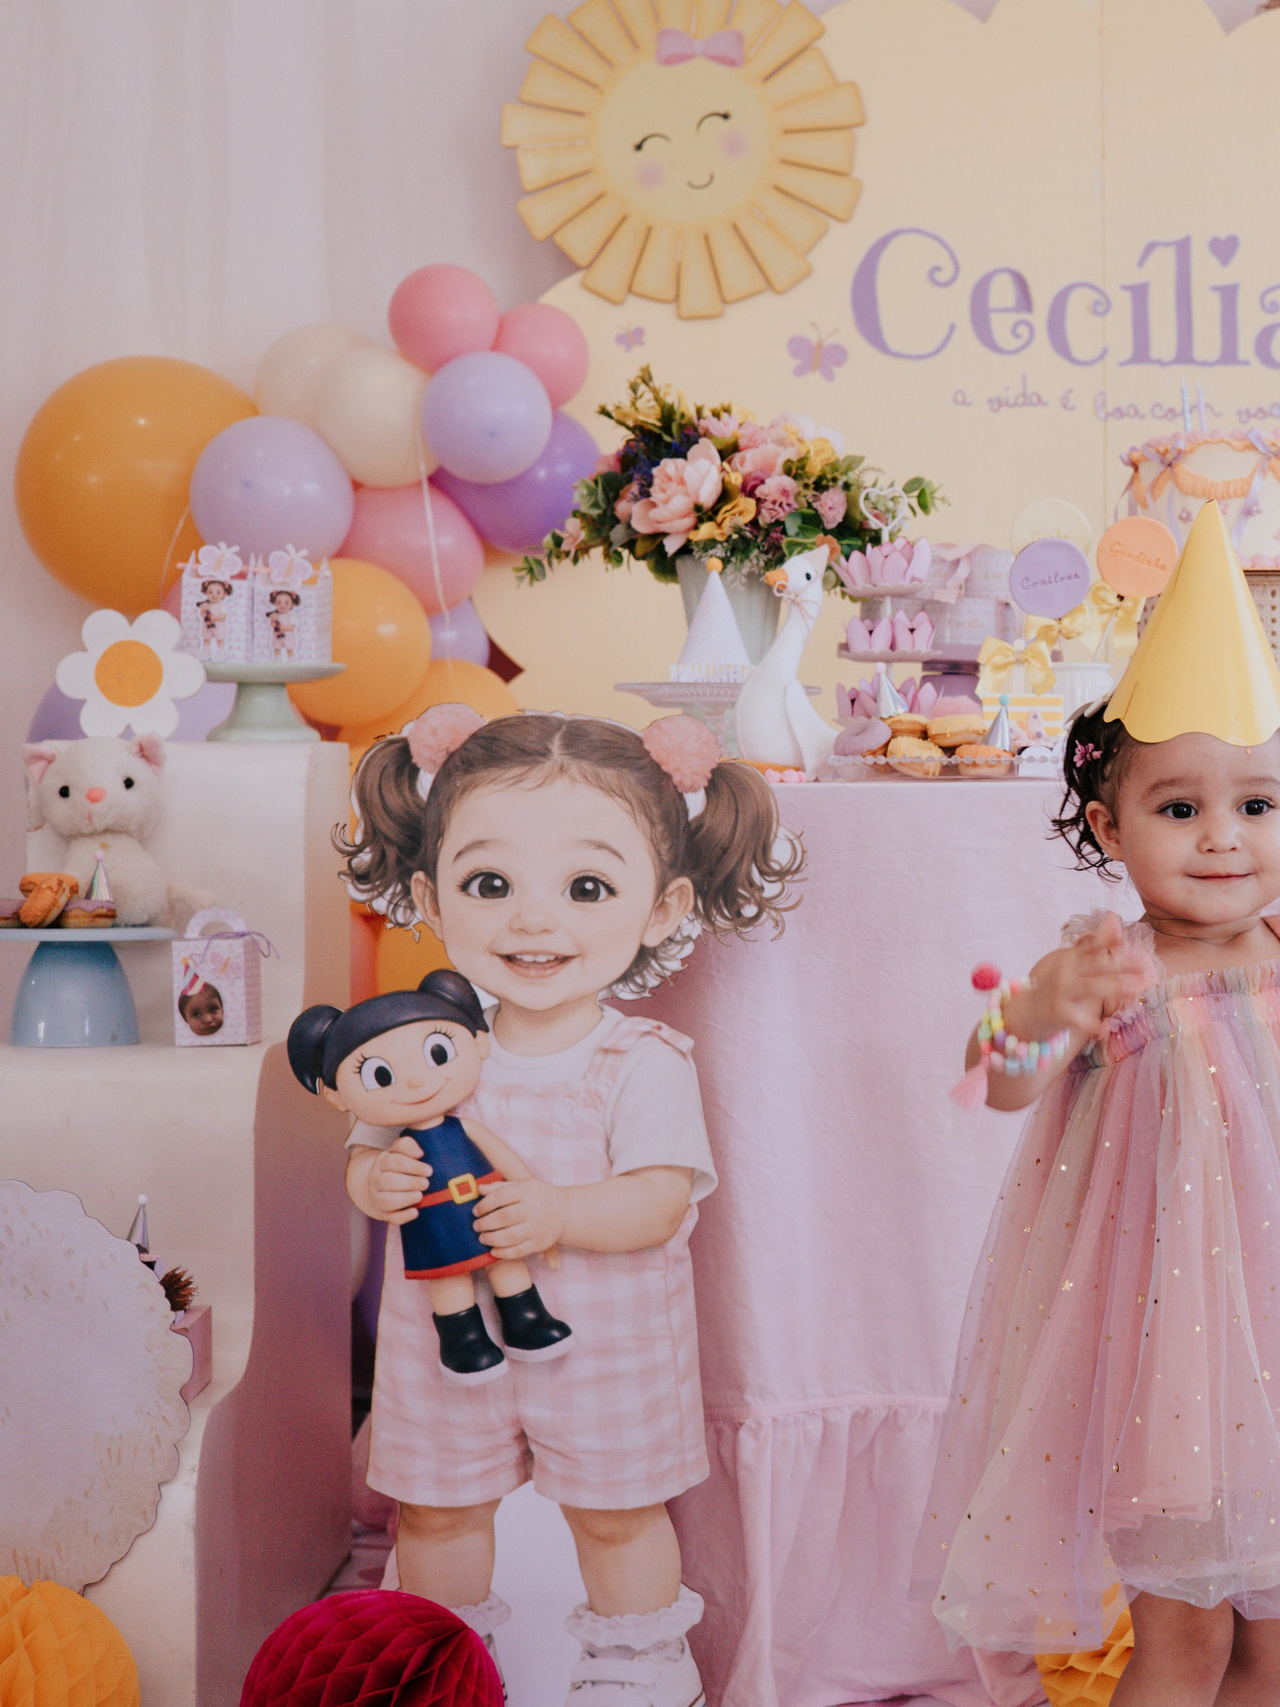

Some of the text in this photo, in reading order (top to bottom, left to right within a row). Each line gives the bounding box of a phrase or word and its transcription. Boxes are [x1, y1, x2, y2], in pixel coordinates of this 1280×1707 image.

[953, 388, 973, 408] a
[987, 372, 1049, 413] vida
[1094, 390, 1147, 422] boa
[1020, 571, 1081, 590] Comilona
